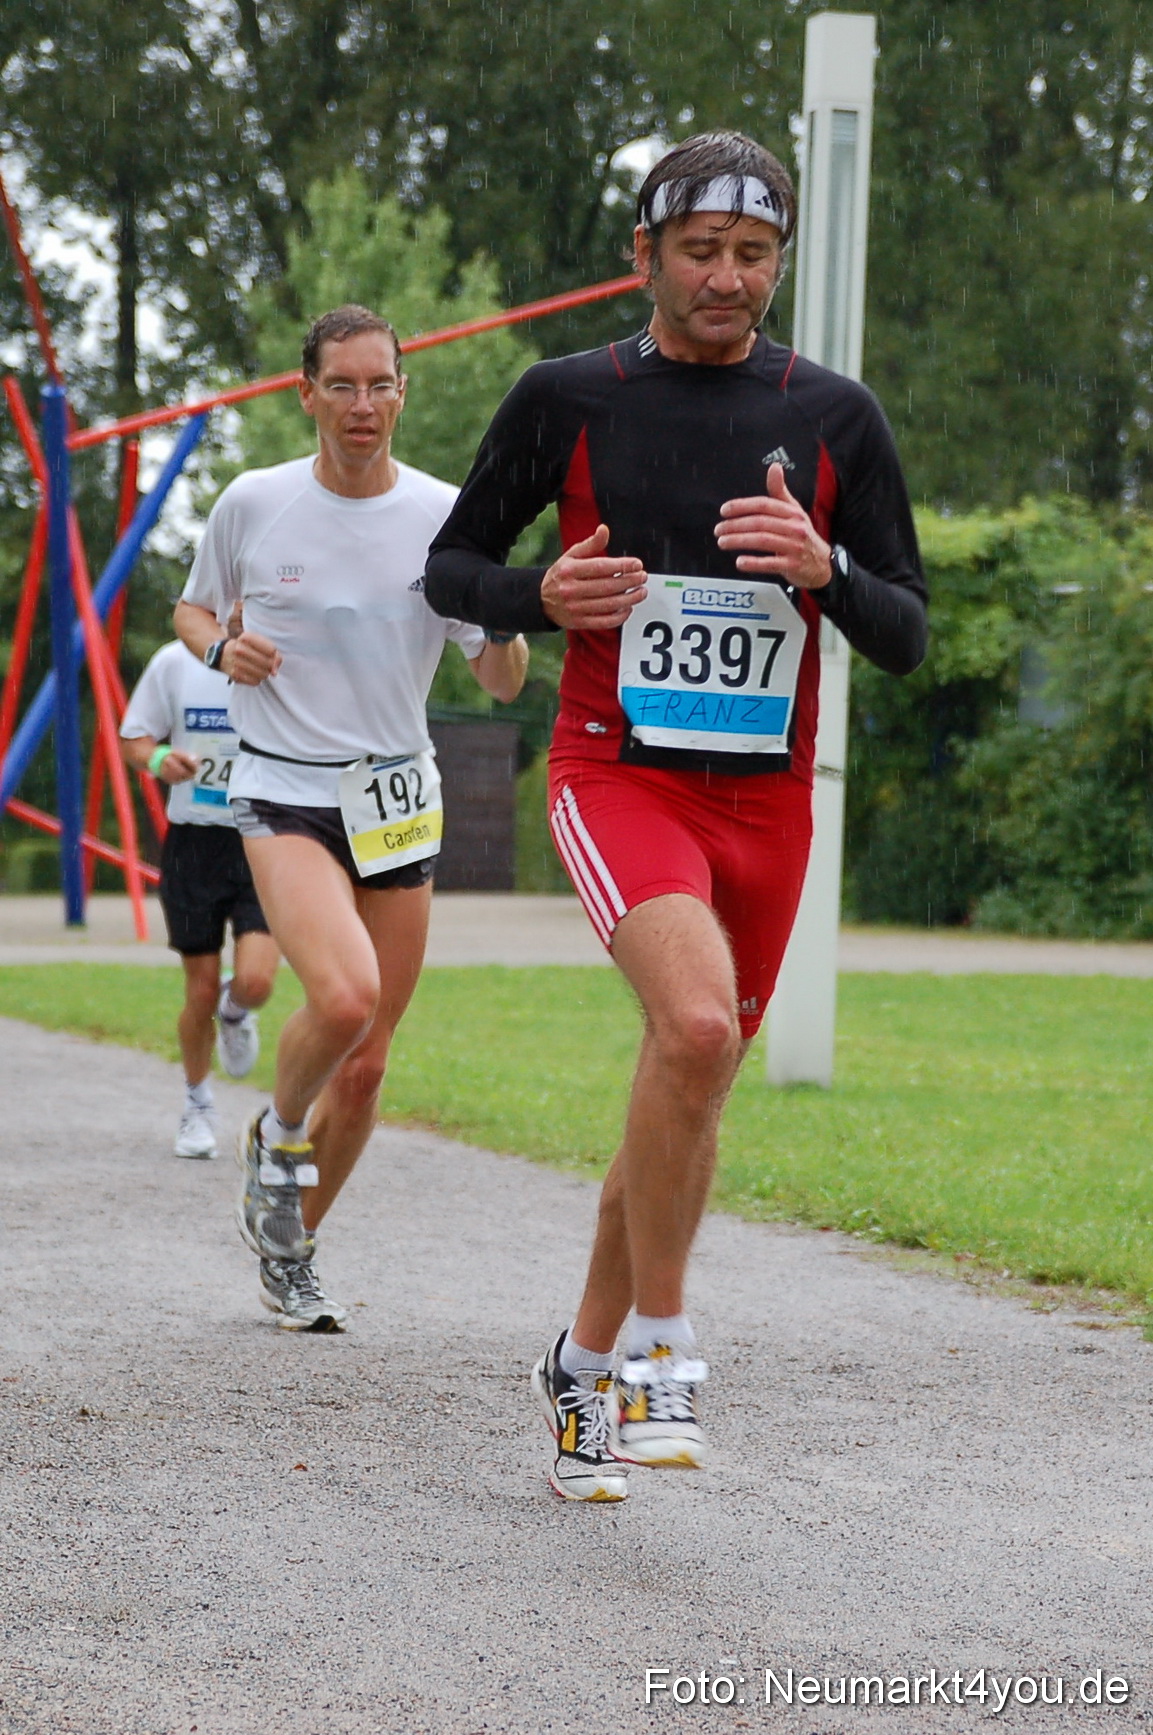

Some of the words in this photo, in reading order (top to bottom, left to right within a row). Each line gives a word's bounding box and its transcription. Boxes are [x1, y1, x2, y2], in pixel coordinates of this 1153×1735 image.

[682, 588, 755, 608] BOCK
[640, 621, 787, 689] 3397
[638, 692, 764, 724] FRANZ
[364, 768, 426, 821] 192
[383, 825, 431, 849] Carsten
